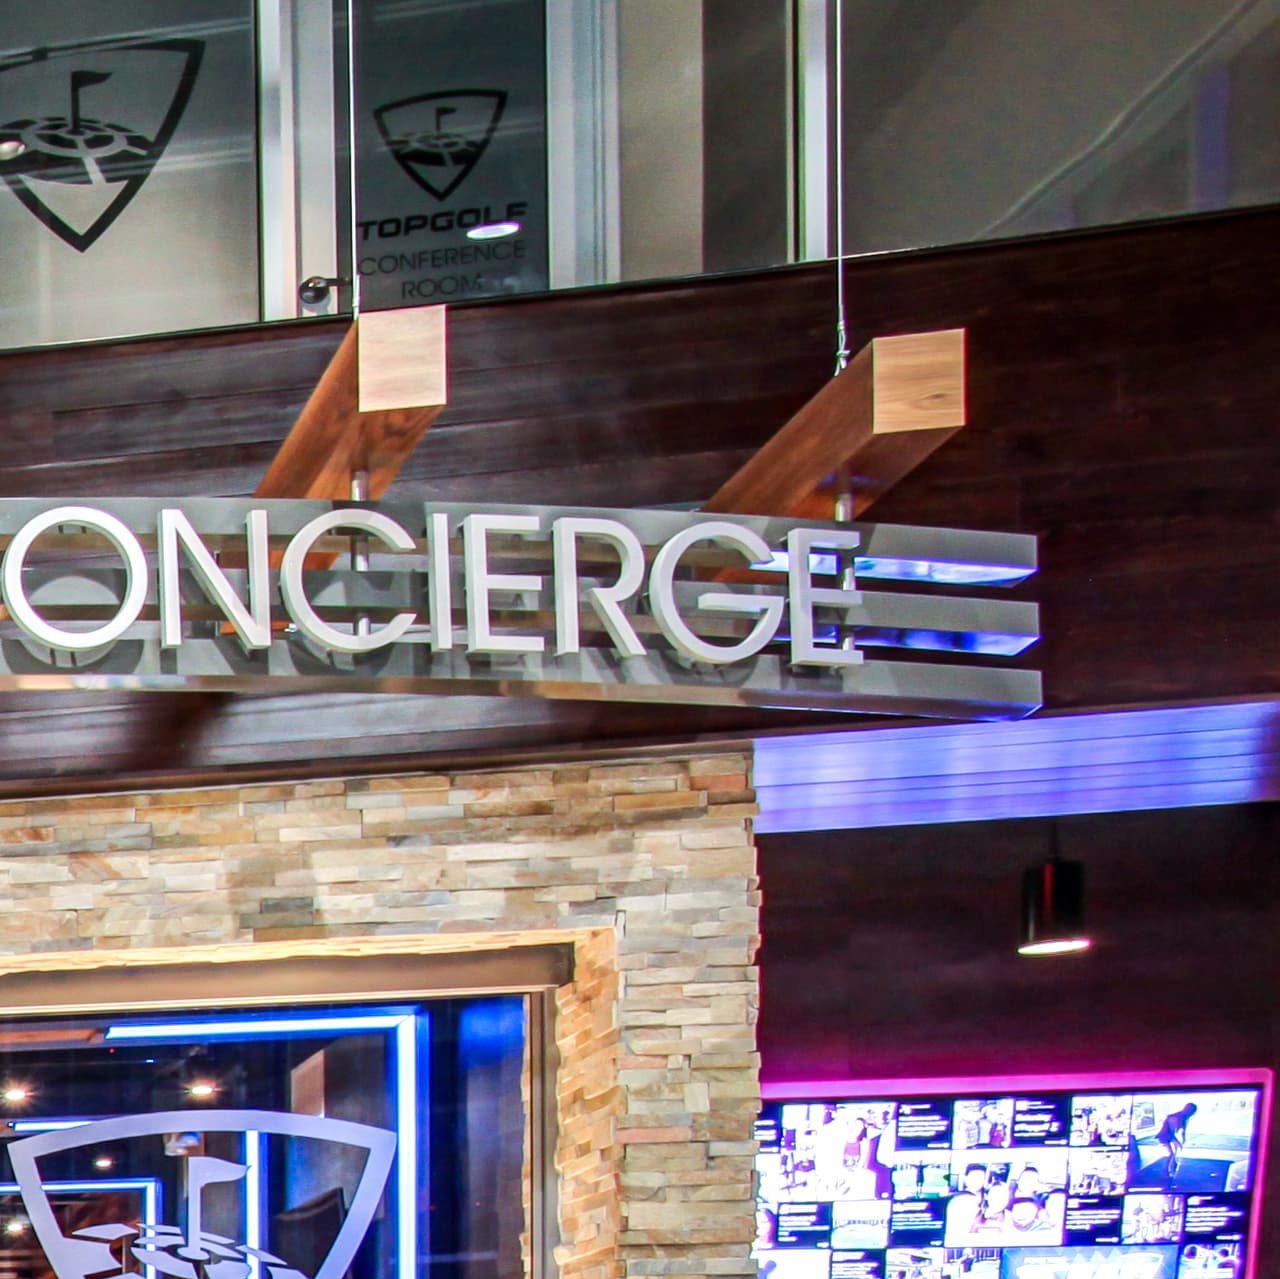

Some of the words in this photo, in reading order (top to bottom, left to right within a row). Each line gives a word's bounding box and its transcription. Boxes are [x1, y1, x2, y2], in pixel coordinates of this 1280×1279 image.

[358, 202, 528, 240] TOPGOLF
[359, 239, 527, 276] CONFERENCE
[401, 273, 483, 299] ROOM
